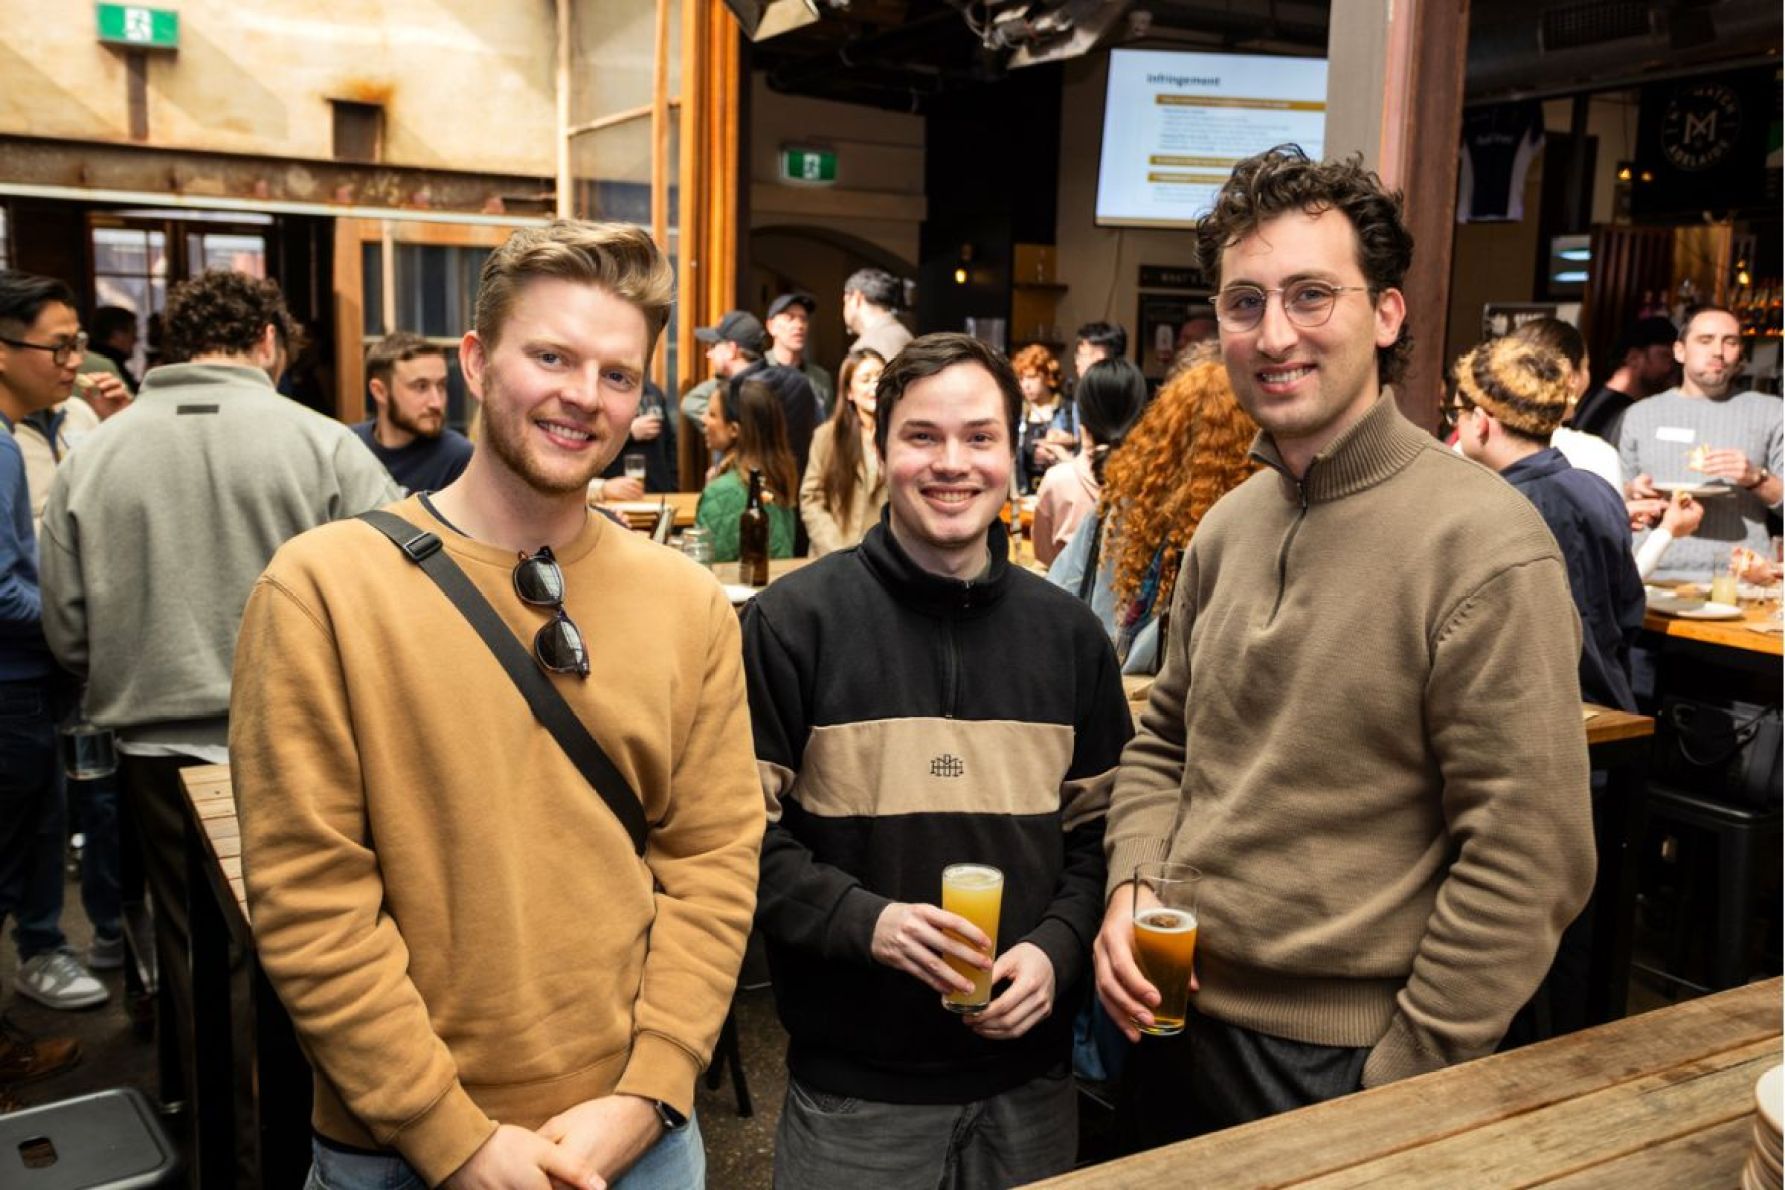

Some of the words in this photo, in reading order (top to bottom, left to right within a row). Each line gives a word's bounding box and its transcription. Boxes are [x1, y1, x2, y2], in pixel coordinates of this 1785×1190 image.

[1146, 72, 1220, 87] Infringement
[1682, 108, 1719, 145] M
[1667, 137, 1729, 167] ADELAIDE
